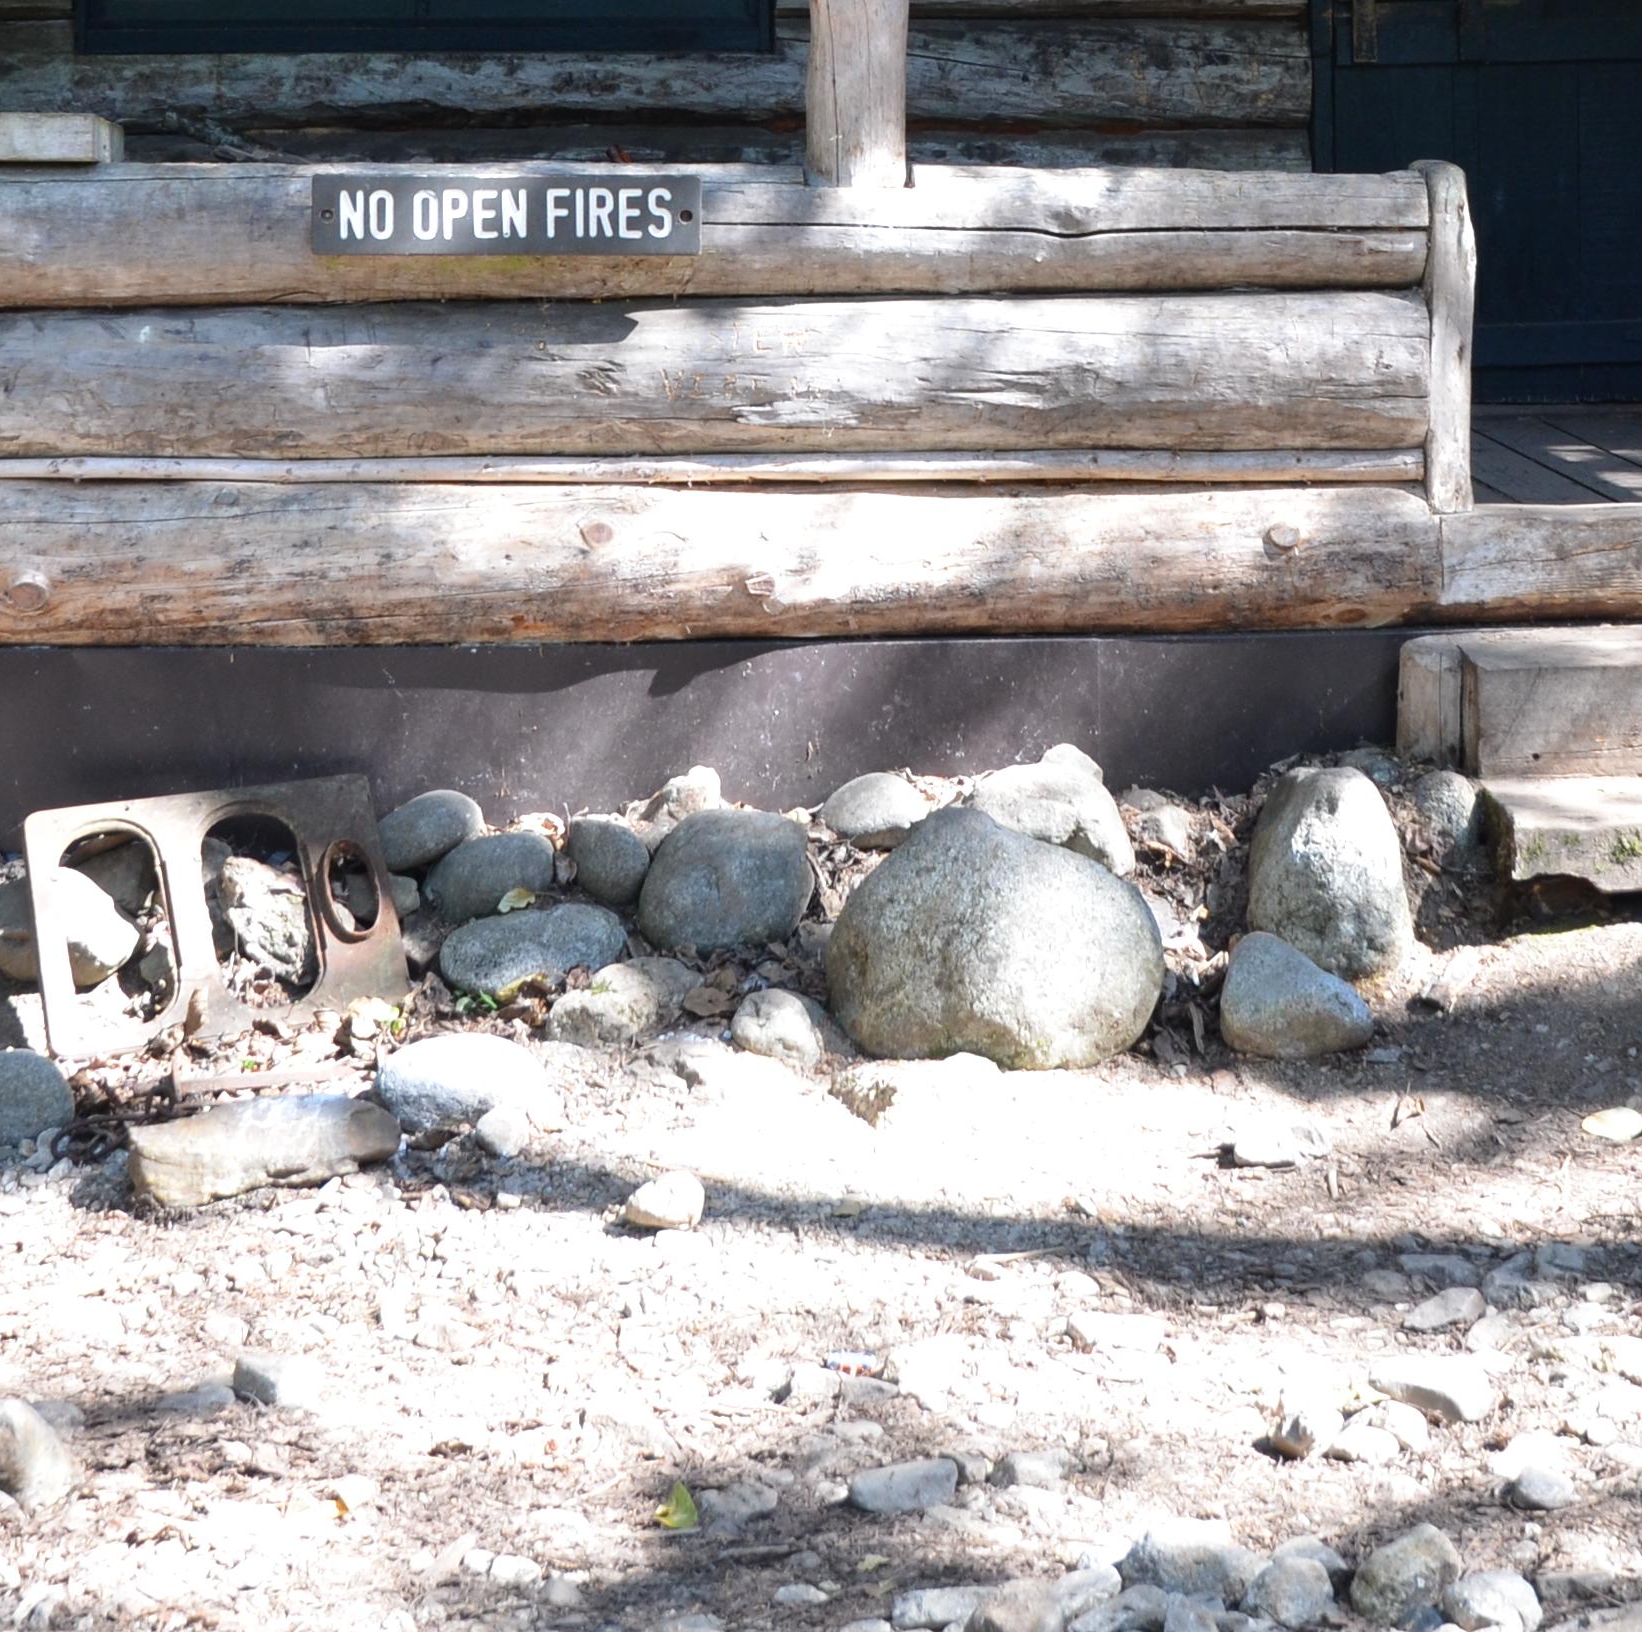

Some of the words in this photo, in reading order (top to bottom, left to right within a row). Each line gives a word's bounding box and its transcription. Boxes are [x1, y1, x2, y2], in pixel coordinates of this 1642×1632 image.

[339, 190, 394, 240] NO
[413, 188, 527, 240] OPEN
[546, 187, 672, 239] FIRES
